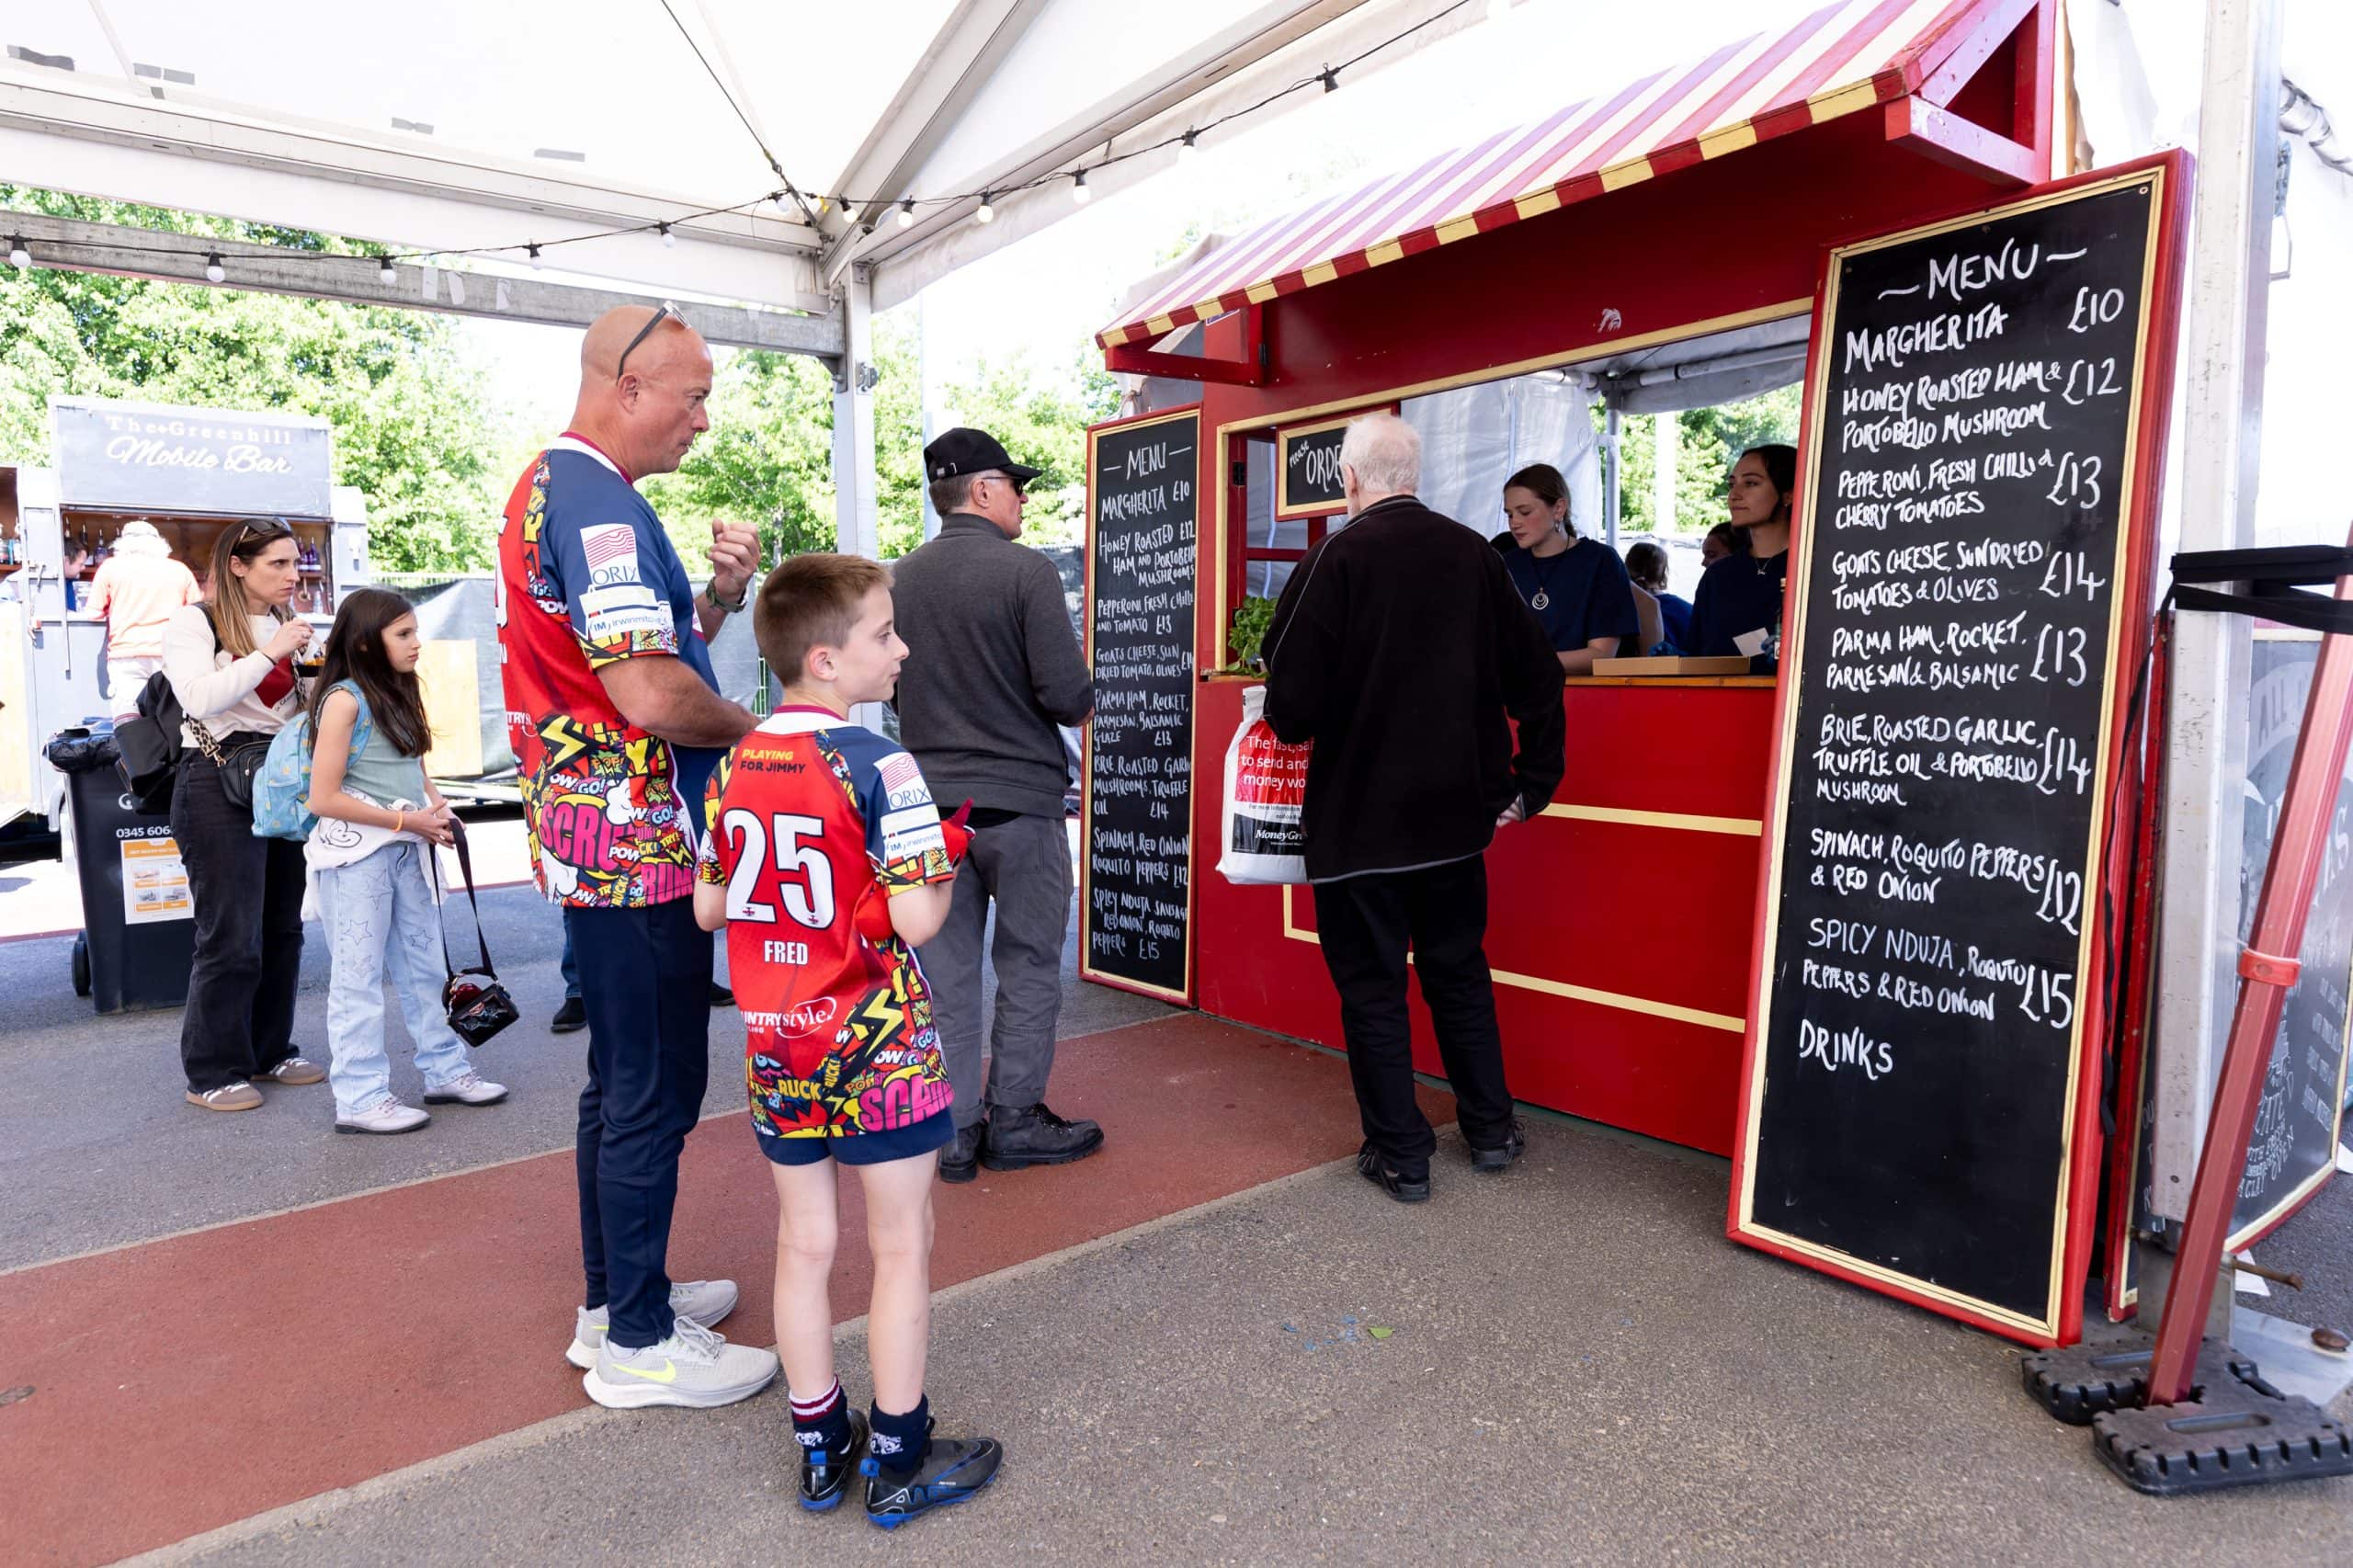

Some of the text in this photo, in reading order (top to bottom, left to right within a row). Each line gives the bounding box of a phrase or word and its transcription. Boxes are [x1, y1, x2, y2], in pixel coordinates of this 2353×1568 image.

[1927, 237, 2039, 301] MENU
[1844, 287, 2124, 373] MARGHERITA £10
[1842, 380, 1913, 421] HONEY
[1916, 368, 1993, 410] ROASTED
[1995, 361, 2051, 392] HAM
[2061, 358, 2123, 404] £12
[167, 421, 293, 445] Greenhill
[1842, 401, 2052, 453] PORTOBELLO MUSHROOM
[106, 435, 293, 473] Mobile Bar
[1126, 441, 1167, 481] MENU
[1306, 444, 1345, 493] ORDE
[1927, 459, 1976, 491] FRESH
[1984, 452, 2036, 480] CHILLI
[2046, 452, 2102, 509] £13
[1101, 481, 1189, 521] MARGHERITA £10
[1836, 491, 1984, 530] CHERRY TOMATOES
[1099, 520, 1195, 563] HONEY ROASTED £12
[592, 565, 637, 585] ORIX
[1113, 555, 1136, 577] HAM
[1138, 554, 1151, 567] AND
[1138, 564, 1195, 587] MUSHROOMS
[1832, 551, 1881, 583] GOATS
[2039, 551, 2106, 601] £14
[1144, 593, 1168, 615] FRESH
[1832, 581, 1913, 615] TOMATOES
[1933, 577, 1999, 604] OLIVES
[1097, 615, 1172, 635] AND TOMATO £13
[1097, 647, 1124, 663] GOATS
[1160, 643, 1179, 661] SUN
[1831, 627, 1892, 659] PARMA
[2029, 623, 2087, 687] £13
[1096, 666, 1119, 683] DRIED
[1156, 665, 1182, 677] OLIVES
[1826, 656, 1910, 692] PARMESAN
[1929, 663, 2020, 690] BALSAMIC
[1095, 689, 1125, 712] PARMA
[1140, 711, 1183, 732] BALSAMIC
[1094, 731, 1172, 752] GLAZE £13
[1246, 736, 1270, 749] The
[742, 749, 794, 761] PLAYING
[1119, 756, 1158, 776] ROASTED
[1241, 754, 1309, 769] to send and
[1813, 748, 1892, 777] TRUFFLE
[1896, 753, 1932, 780] OIL
[1949, 755, 2037, 782] PORTOBELLO
[1872, 715, 1950, 742] ROASTED
[2036, 727, 2091, 794] £14
[739, 761, 806, 774] FOR JIMMY
[578, 778, 606, 795] GO!
[1152, 779, 1188, 798] TRUFFLE
[1244, 774, 1285, 790] money
[1816, 778, 1907, 806] MUSHROOM
[890, 788, 931, 808] ORIX
[1094, 801, 1169, 820] OIL £14
[116, 825, 171, 838] 0345 606
[1139, 833, 1155, 857] RED
[1159, 833, 1189, 857] ONION
[723, 808, 835, 930] 25
[1092, 854, 1188, 888] ROQUITO PEPPERS £12
[1833, 864, 1868, 895] RED
[1878, 872, 1941, 904] ONION
[1890, 835, 1965, 874] ROQUITO
[1969, 842, 2045, 893] PEPPERS
[2035, 858, 2081, 936] £12
[1093, 887, 1118, 916] SPICY
[1121, 890, 1151, 919] NDUJA
[1104, 913, 1119, 930] RED
[764, 940, 809, 965] FRED
[1140, 938, 1159, 960] £15
[1808, 917, 1876, 955] SPICY
[2019, 964, 2073, 1028] £15
[1803, 959, 1870, 998] PEPPERS
[1894, 976, 1931, 1008] RED
[1938, 987, 1995, 1021] ONION
[1800, 1018, 1893, 1081] DRINKS
[778, 1079, 822, 1100] RUCK
